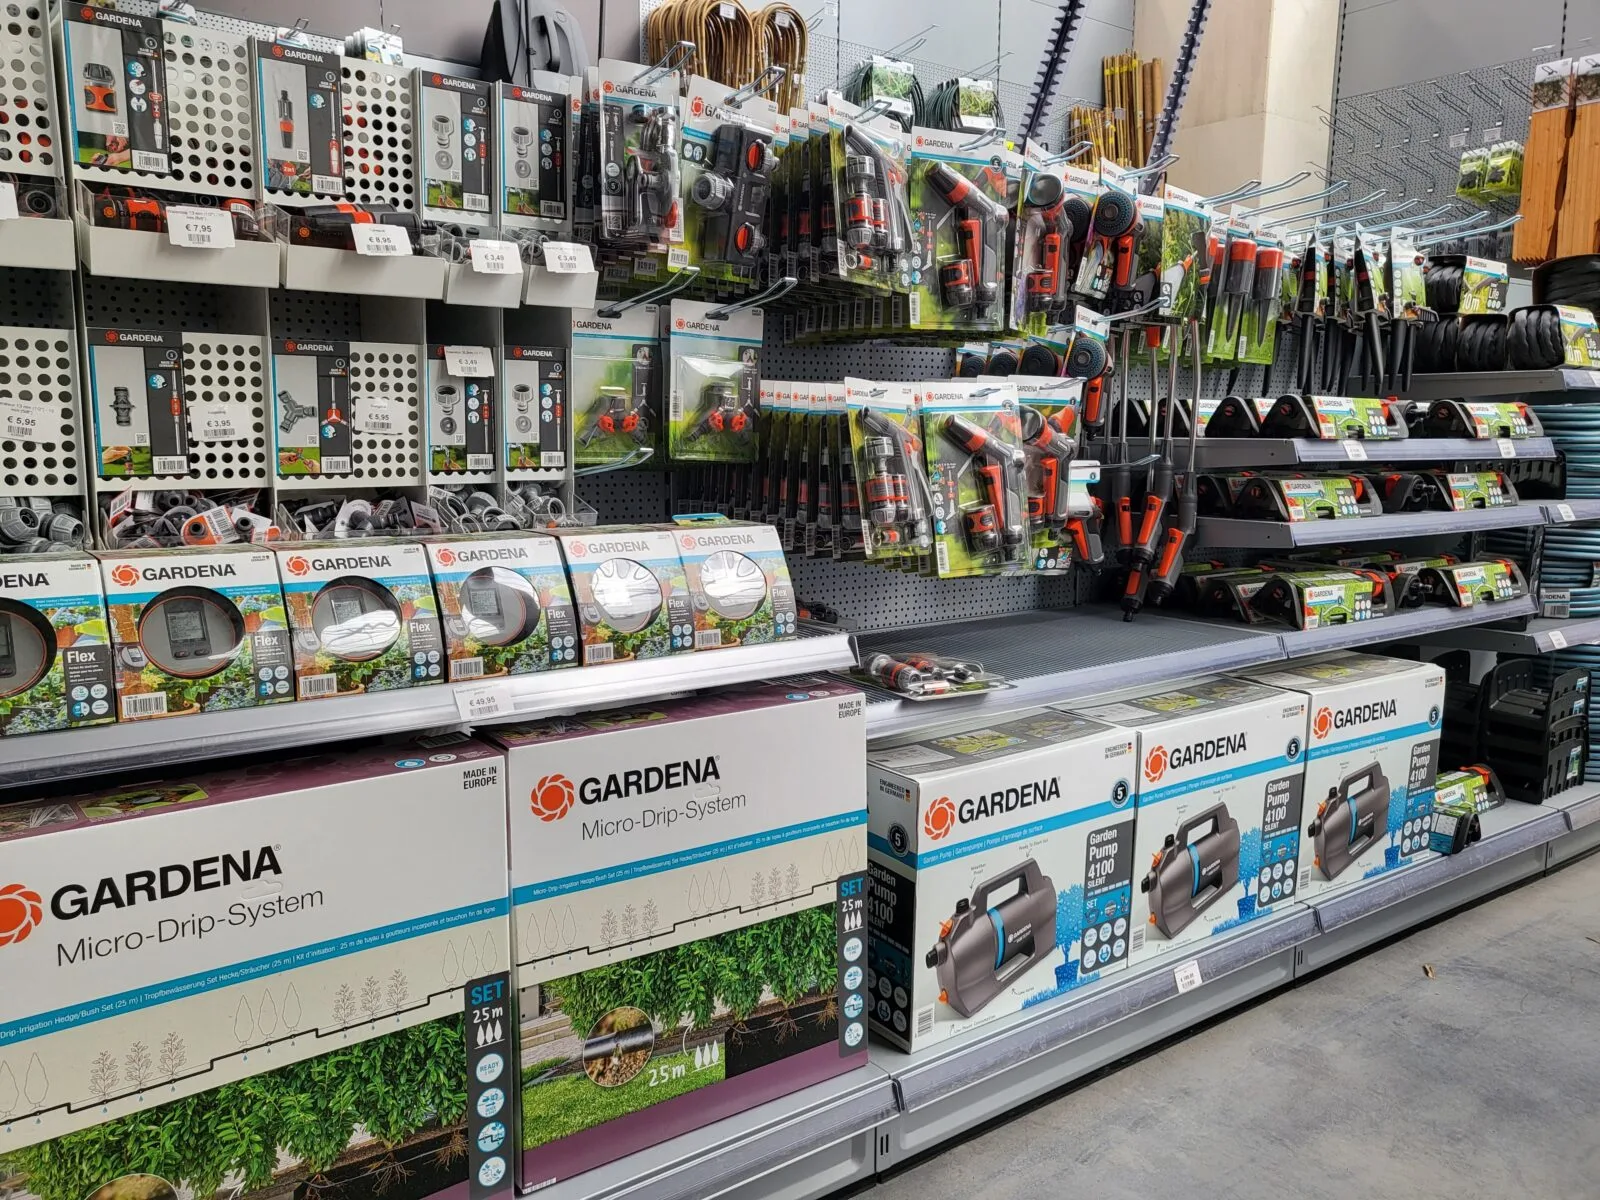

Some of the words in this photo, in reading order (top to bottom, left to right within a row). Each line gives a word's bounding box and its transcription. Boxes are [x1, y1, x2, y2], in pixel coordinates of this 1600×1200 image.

[95, 12, 142, 27] GARDENA
[284, 49, 323, 63] GARDENA
[442, 78, 476, 90] GARDENA
[521, 91, 552, 102] GARDENA
[615, 84, 657, 98] GARDENA
[924, 138, 954, 149] GARDENA
[1069, 174, 1088, 185] GARDENA
[1172, 193, 1188, 202] GARDENA
[1142, 202, 1162, 210] GARDENA
[193, 224, 212, 232] 7,95
[1260, 230, 1278, 239] GARDENA
[576, 320, 612, 330] GARDENA
[686, 322, 720, 332] GARDENA
[120, 333, 164, 342] GARDENA
[296, 344, 334, 352] GARDENA
[16, 418, 36, 426] 5,95
[214, 420, 231, 428] 3,95
[588, 540, 650, 554] GARDENA
[698, 534, 755, 547] GARDENA
[458, 548, 528, 563] GARDENA
[312, 556, 392, 570] GARDENA
[142, 564, 236, 581] GARDENA
[0, 573, 50, 588] ENA
[772, 588, 787, 598] Flex
[1314, 590, 1334, 598] GARDENA
[668, 598, 684, 608] Flex
[548, 608, 566, 619] Flex
[410, 622, 431, 632] Flex
[255, 635, 278, 646] Flex
[67, 650, 96, 664] Flex
[476, 696, 496, 705] 49,95
[838, 702, 854, 710] MADE
[838, 708, 862, 718] EUROPE
[1334, 699, 1397, 729] GARDENA
[1430, 711, 1437, 721] 5
[1104, 742, 1128, 752] ENGINEERED
[1110, 749, 1127, 758] GERMANY
[1170, 732, 1247, 770] GARDENA
[1290, 744, 1296, 755] 5
[1413, 744, 1430, 755] Garden
[1412, 755, 1430, 768] Pump
[463, 768, 486, 779] MADE
[489, 766, 497, 774] IN
[1410, 767, 1428, 782] 4100
[464, 776, 497, 790] EUROPE
[579, 756, 721, 805] GARDENA
[880, 778, 904, 794] ENGINEERED
[1267, 780, 1290, 794] Garden
[884, 787, 904, 800] GERMANY
[1117, 786, 1124, 798] 5
[959, 777, 1061, 824] GARDENA
[1266, 792, 1290, 808] Pump
[582, 793, 747, 841] Micro-Drip-System
[1265, 806, 1286, 824] 4100
[1264, 822, 1278, 832] SILENT
[895, 833, 901, 846] 5
[1090, 829, 1118, 845] Garden
[1089, 842, 1118, 862] Pump
[1262, 842, 1272, 851] SET
[868, 862, 896, 886] Garden
[1088, 858, 1114, 879] 4100
[51, 845, 282, 920] GARDENA
[840, 877, 864, 898] SET
[1088, 876, 1106, 889] SILENT
[868, 877, 896, 906] Pump
[868, 896, 894, 924] 4100
[1086, 898, 1098, 910] SET
[57, 890, 324, 967] Micro-Drip-System
[54, 1006, 100, 1025] Hedge/Bush
[101, 1002, 114, 1013] Set
[115, 999, 127, 1011] (25
[128, 996, 139, 1006] m)
[145, 979, 206, 1002] Tropfbewässerung
[206, 976, 218, 985] Set
[219, 962, 270, 984] Hecke/Sträucher
[272, 960, 282, 969] (25
[283, 956, 292, 966] m)
[296, 953, 304, 962] Kit
[306, 945, 336, 959] d'initiation
[340, 942, 348, 950] 25
[356, 938, 364, 946] de
[484, 906, 496, 914] ligne
[471, 980, 504, 1006] SET
[480, 1062, 499, 1073] READY
